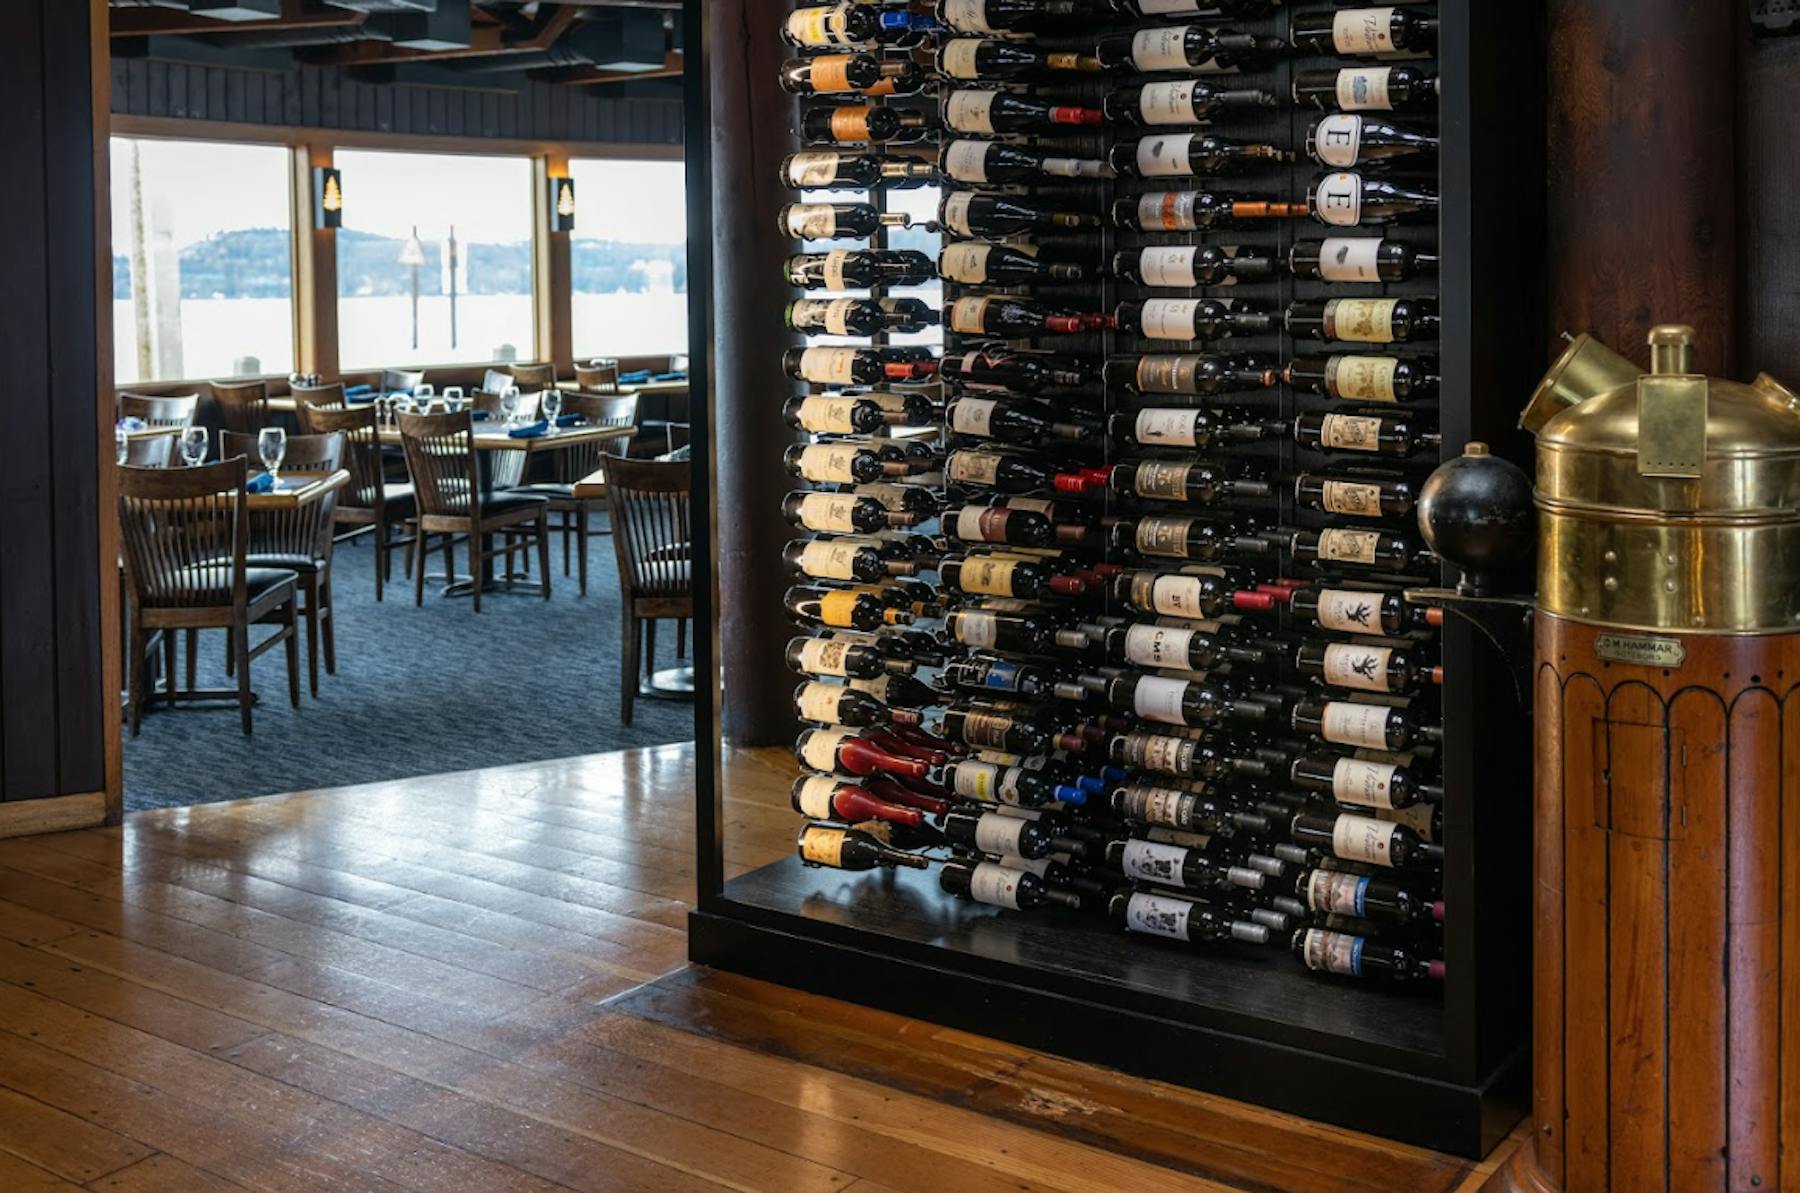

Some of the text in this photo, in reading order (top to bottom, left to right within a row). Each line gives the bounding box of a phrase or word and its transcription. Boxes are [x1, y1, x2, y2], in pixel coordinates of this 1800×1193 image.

[1327, 130, 1351, 146] E
[1327, 191, 1351, 209] E
[1153, 631, 1165, 662] CMS
[1622, 640, 1672, 654] HAMMAR
